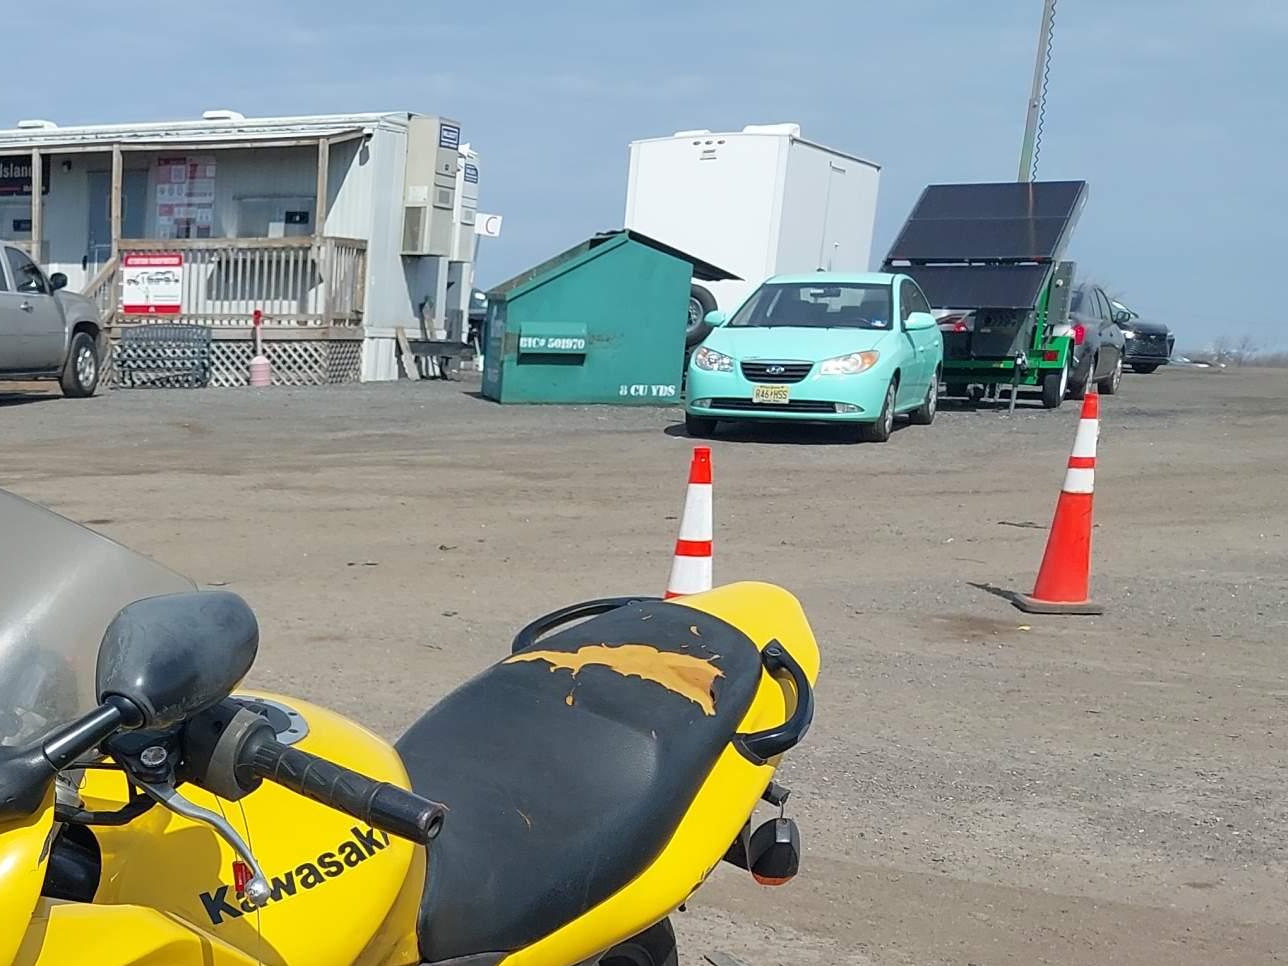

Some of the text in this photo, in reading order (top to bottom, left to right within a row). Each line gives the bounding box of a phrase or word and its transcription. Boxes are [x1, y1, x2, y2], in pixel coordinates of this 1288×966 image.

[485, 216, 497, 234] C
[547, 337, 585, 349] 501970
[619, 384, 676, 397] 8 CU YDS
